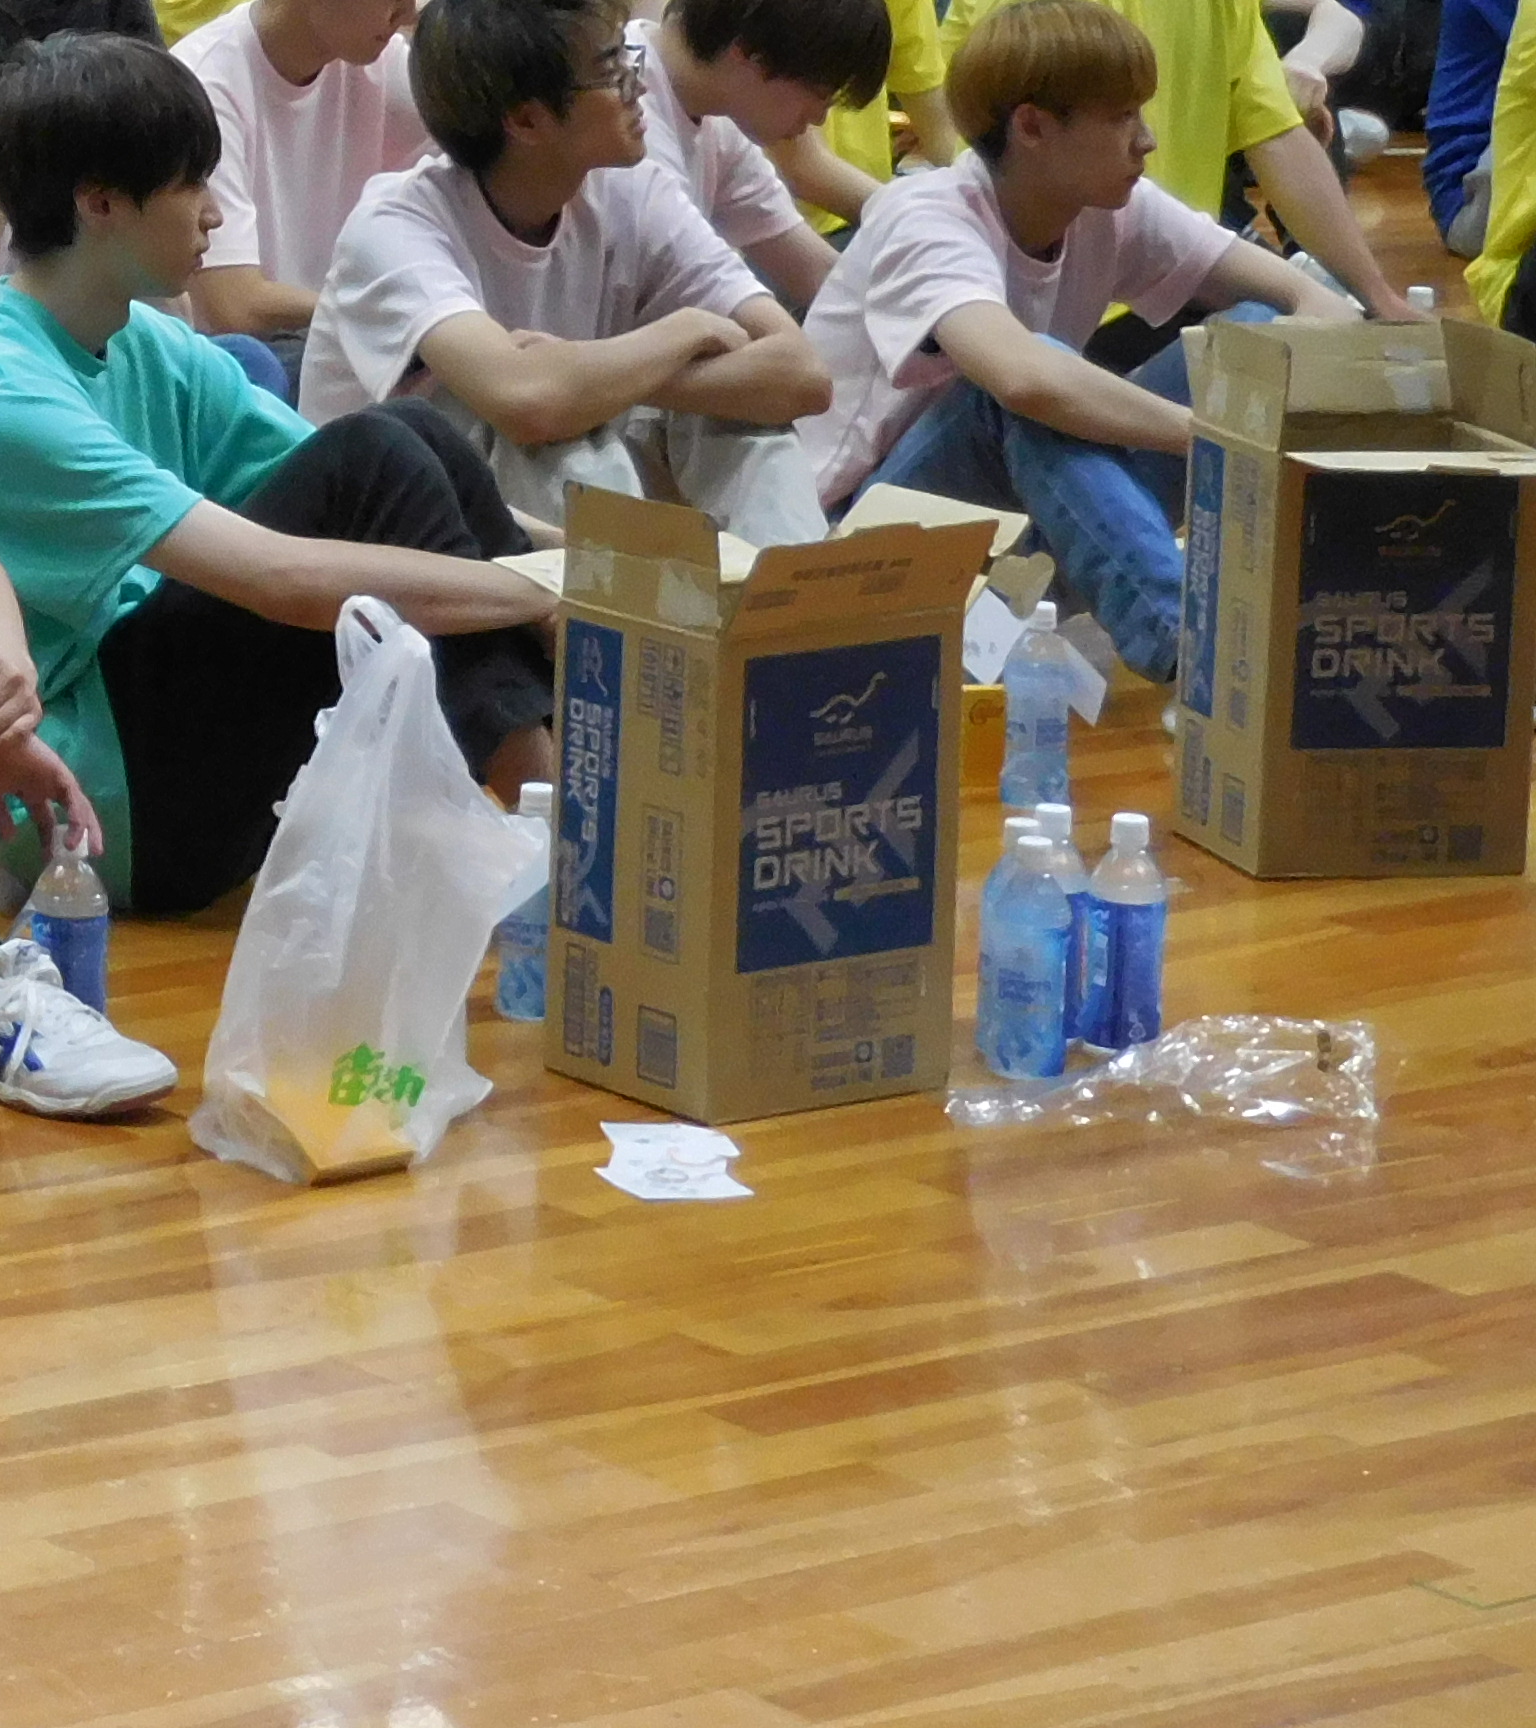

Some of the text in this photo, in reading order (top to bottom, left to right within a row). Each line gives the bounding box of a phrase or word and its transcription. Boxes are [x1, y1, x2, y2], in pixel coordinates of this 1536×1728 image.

[1313, 613, 1496, 644] SPORTS
[1310, 648, 1446, 678] DRINK
[756, 795, 923, 850] SPORTS
[753, 841, 878, 890] DRINK
